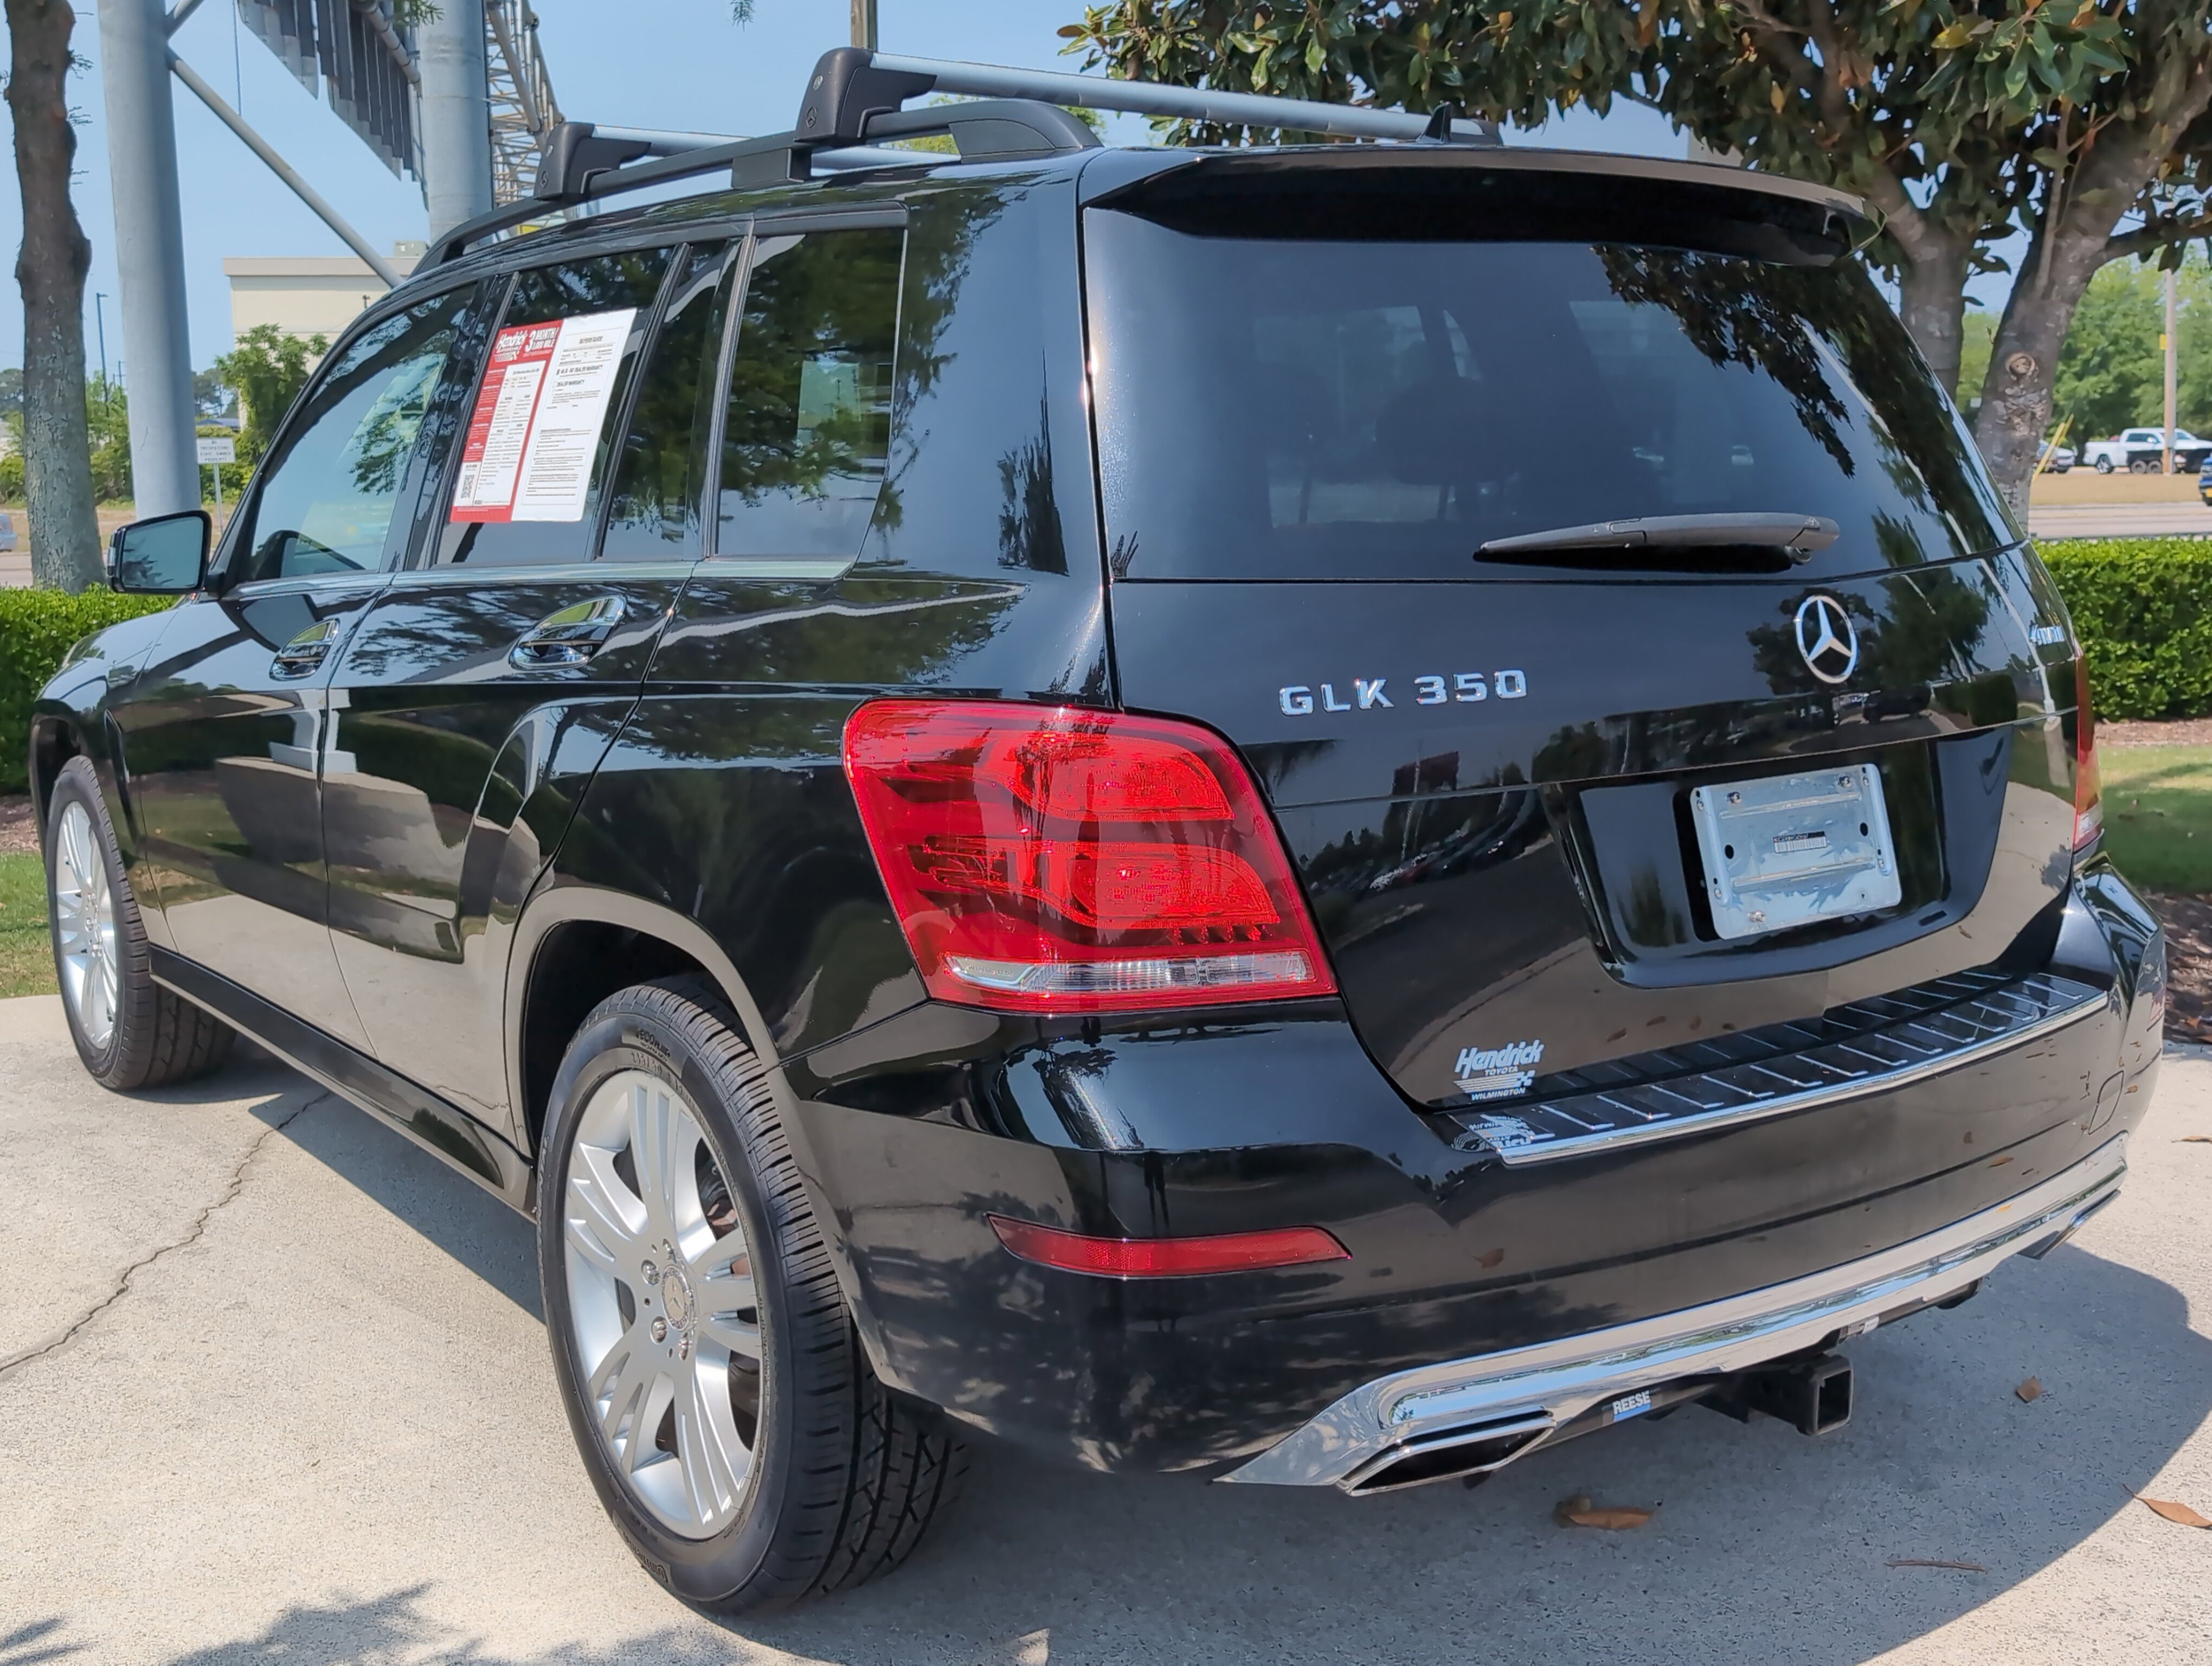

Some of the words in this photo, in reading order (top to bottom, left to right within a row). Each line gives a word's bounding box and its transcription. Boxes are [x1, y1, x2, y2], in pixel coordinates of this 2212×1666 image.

[1278, 677, 1394, 716] GLK
[1414, 669, 1528, 705] 350
[1455, 1039, 1545, 1079] Hendrick
[1484, 1066, 1519, 1077] TOYOTA
[1471, 1087, 1526, 1101] WILMINGTON
[1612, 1390, 1650, 1414] REESE
